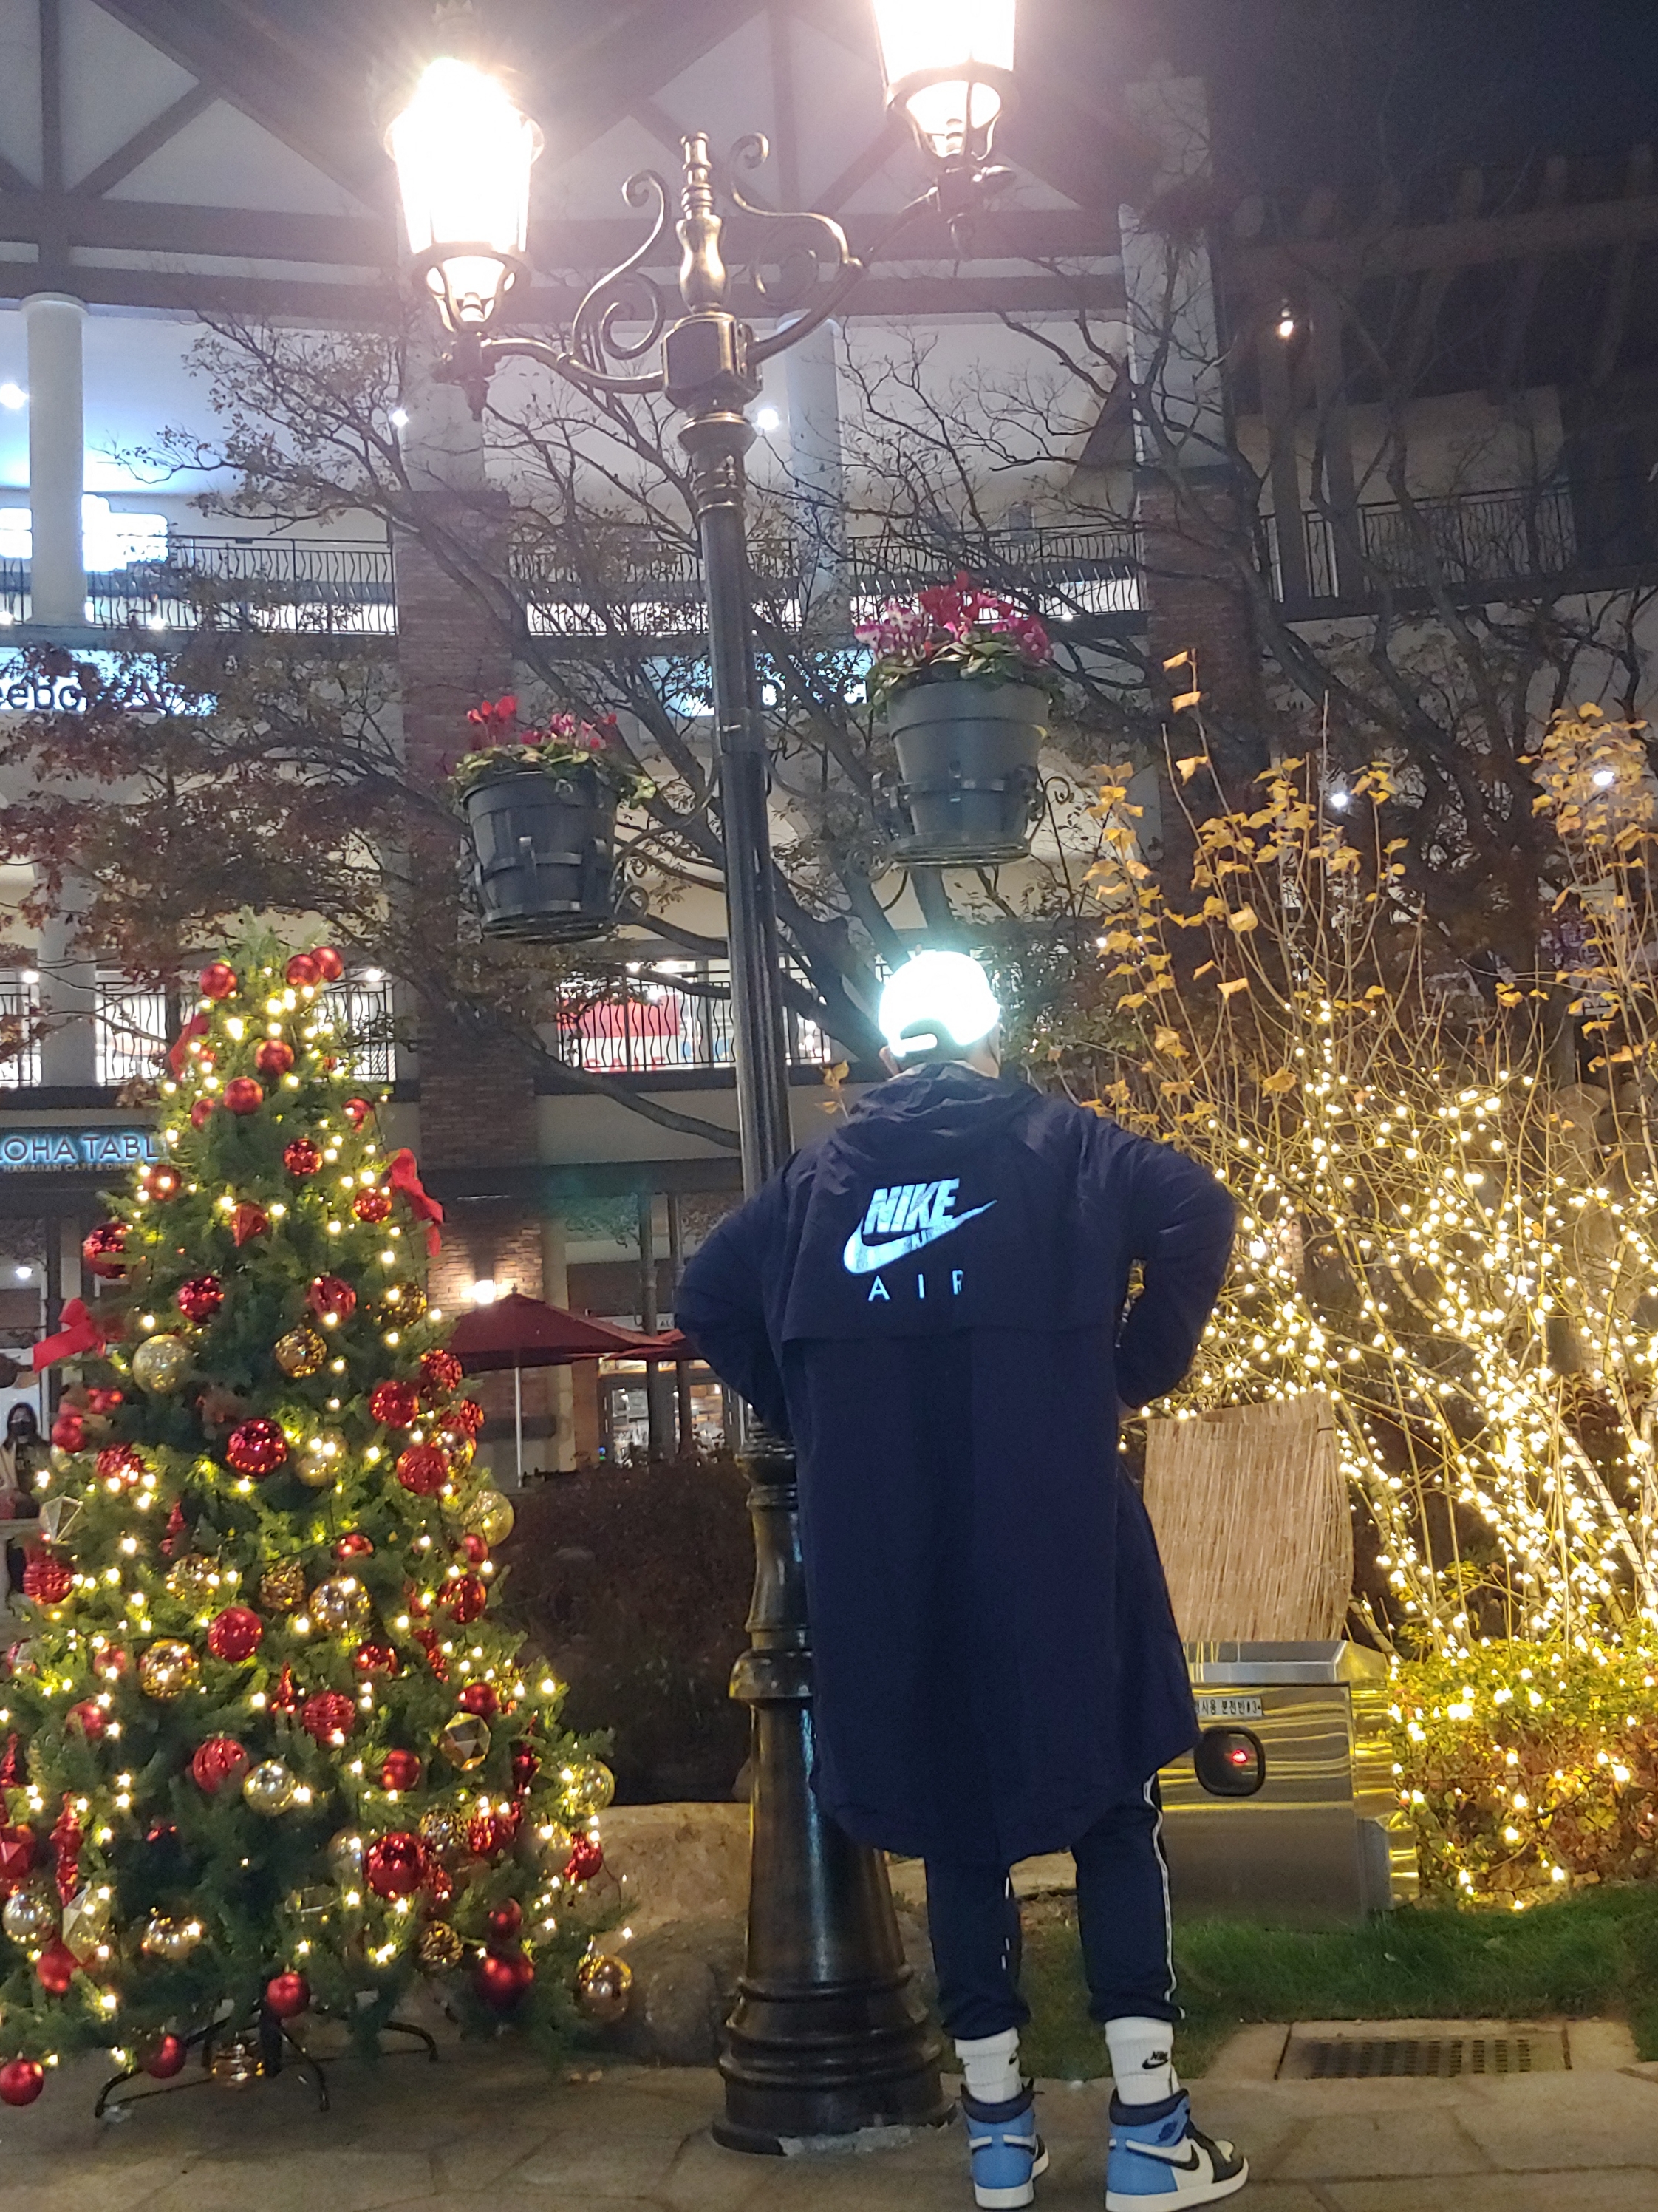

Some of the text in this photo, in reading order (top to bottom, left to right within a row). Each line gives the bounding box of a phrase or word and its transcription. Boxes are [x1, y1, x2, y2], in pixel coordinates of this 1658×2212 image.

[0, 1136, 160, 1161] OHA TABL
[863, 1178, 960, 1235] NIKE
[868, 1270, 963, 1301] AIR
